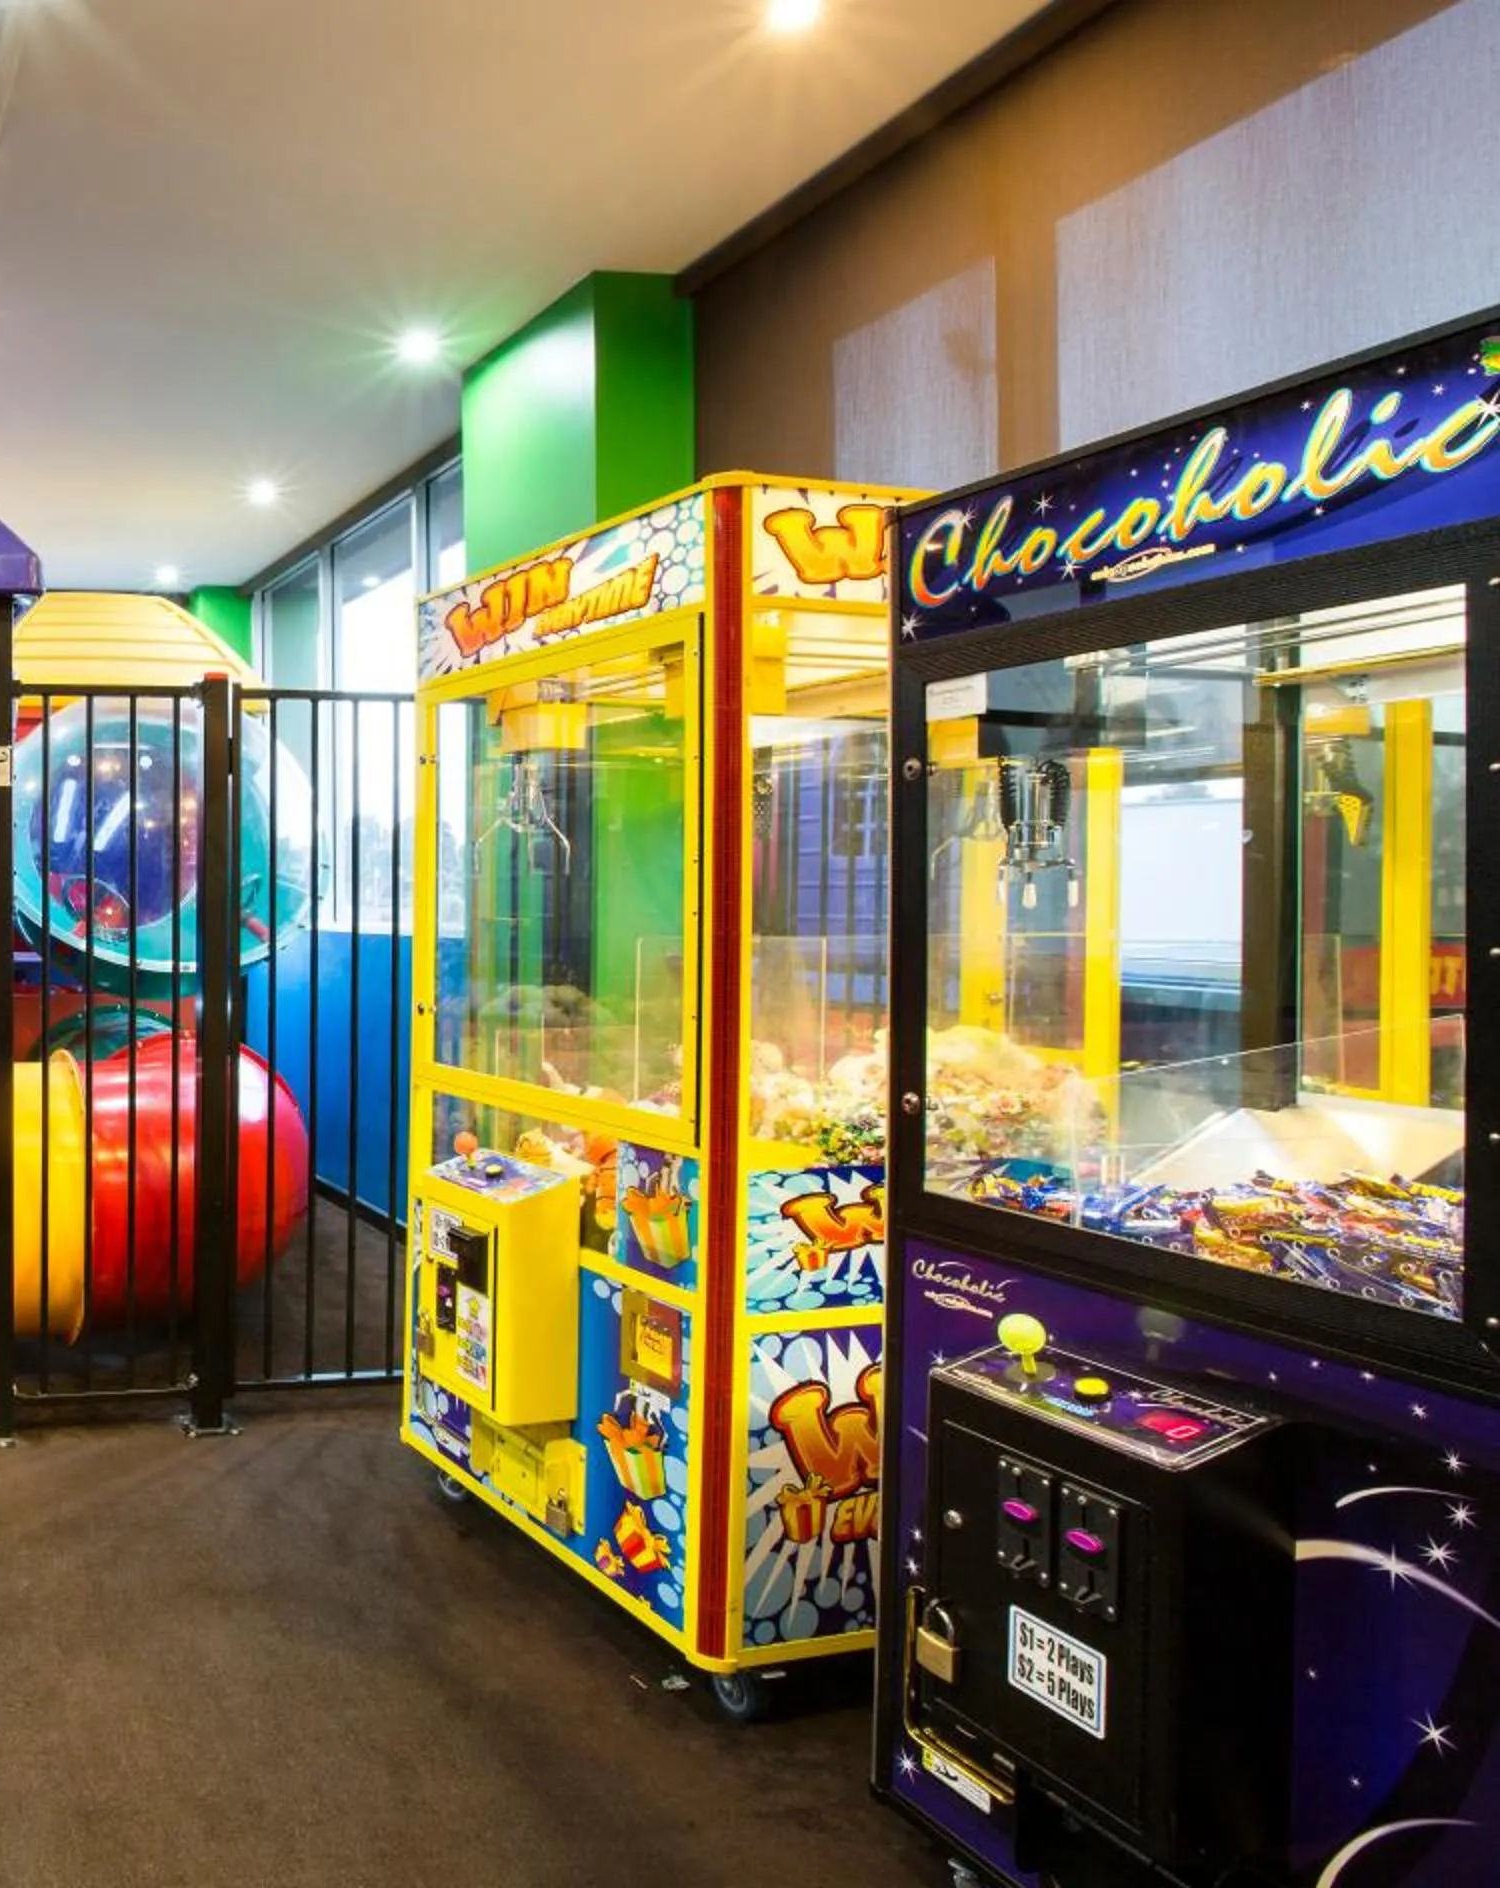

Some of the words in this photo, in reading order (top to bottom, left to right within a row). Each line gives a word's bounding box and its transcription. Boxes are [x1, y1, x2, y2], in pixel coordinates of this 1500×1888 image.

[910, 388, 1500, 607] Chocoholic
[446, 557, 574, 658] WIN
[1057, 1643, 1094, 1685] Plays
[1058, 1677, 1095, 1719] Plays
